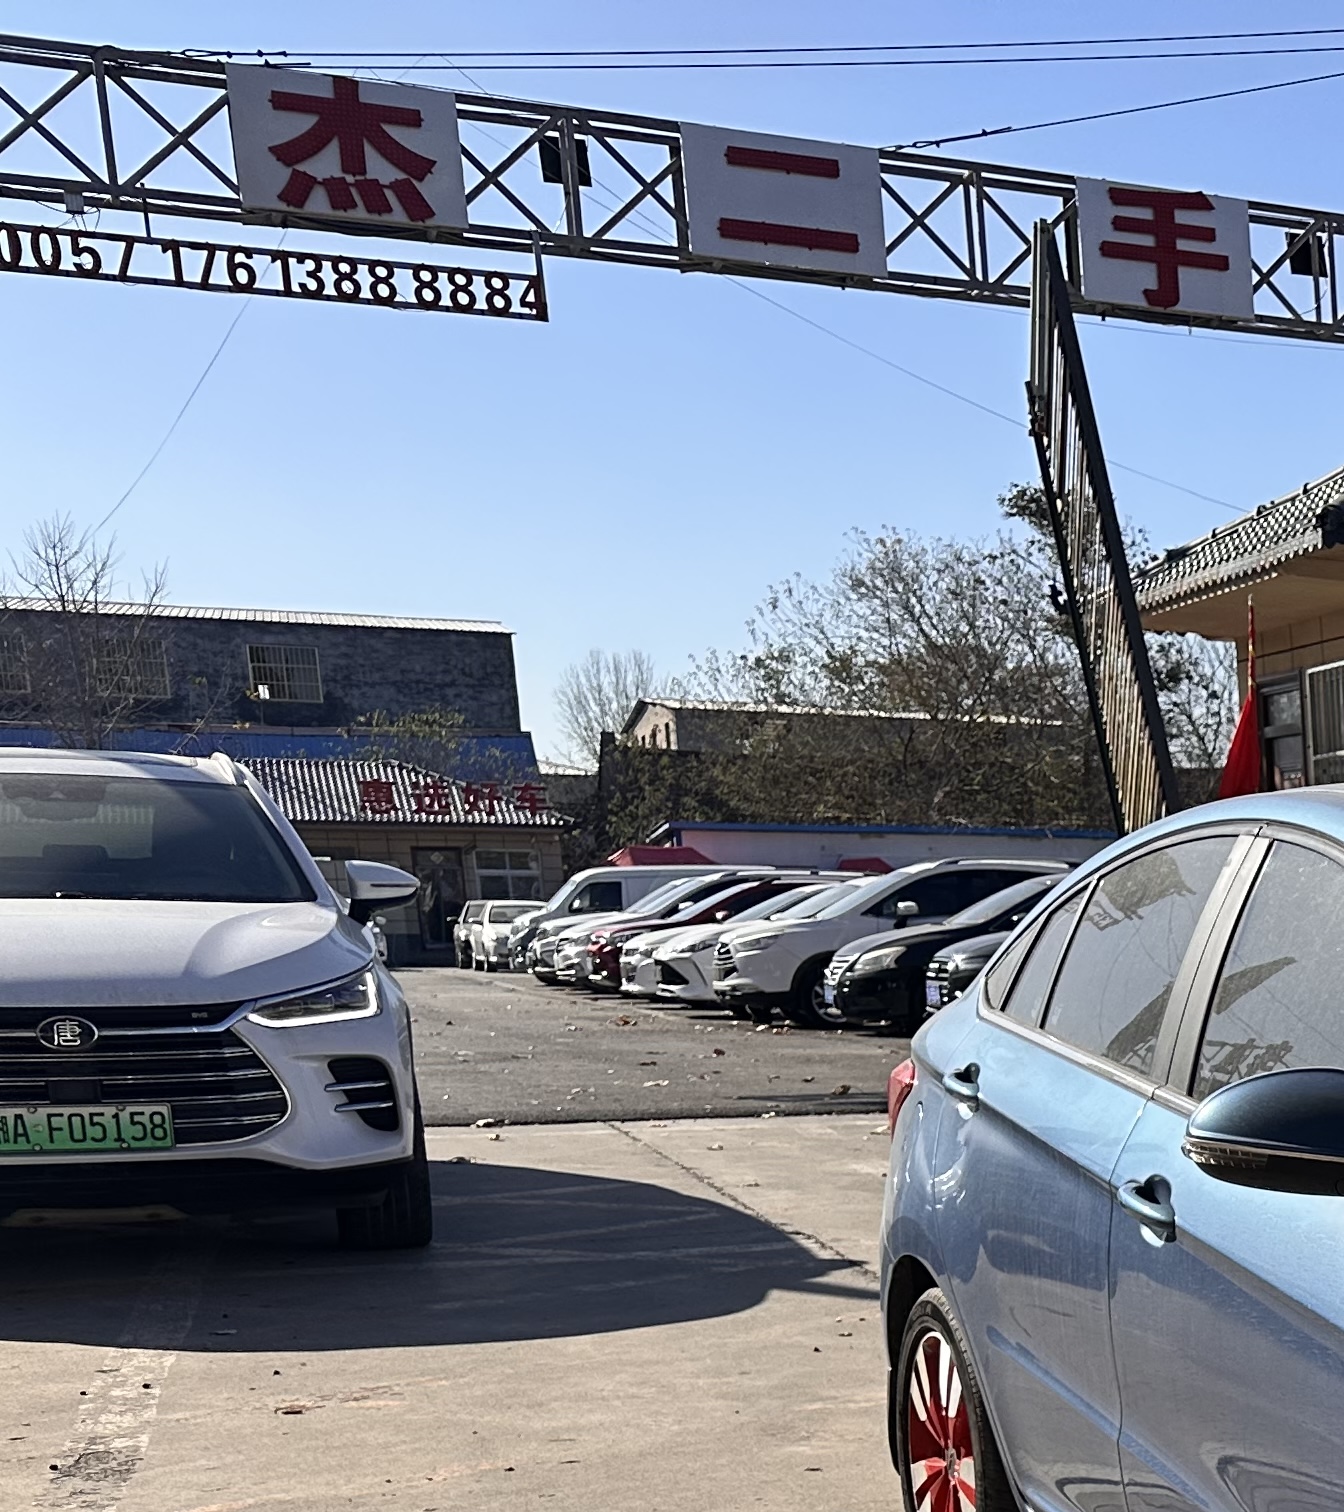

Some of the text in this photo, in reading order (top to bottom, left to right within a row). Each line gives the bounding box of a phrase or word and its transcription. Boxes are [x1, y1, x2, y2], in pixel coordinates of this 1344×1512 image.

[161, 239, 257, 291] 176
[270, 250, 397, 304] 1388
[412, 263, 548, 321] 8884
